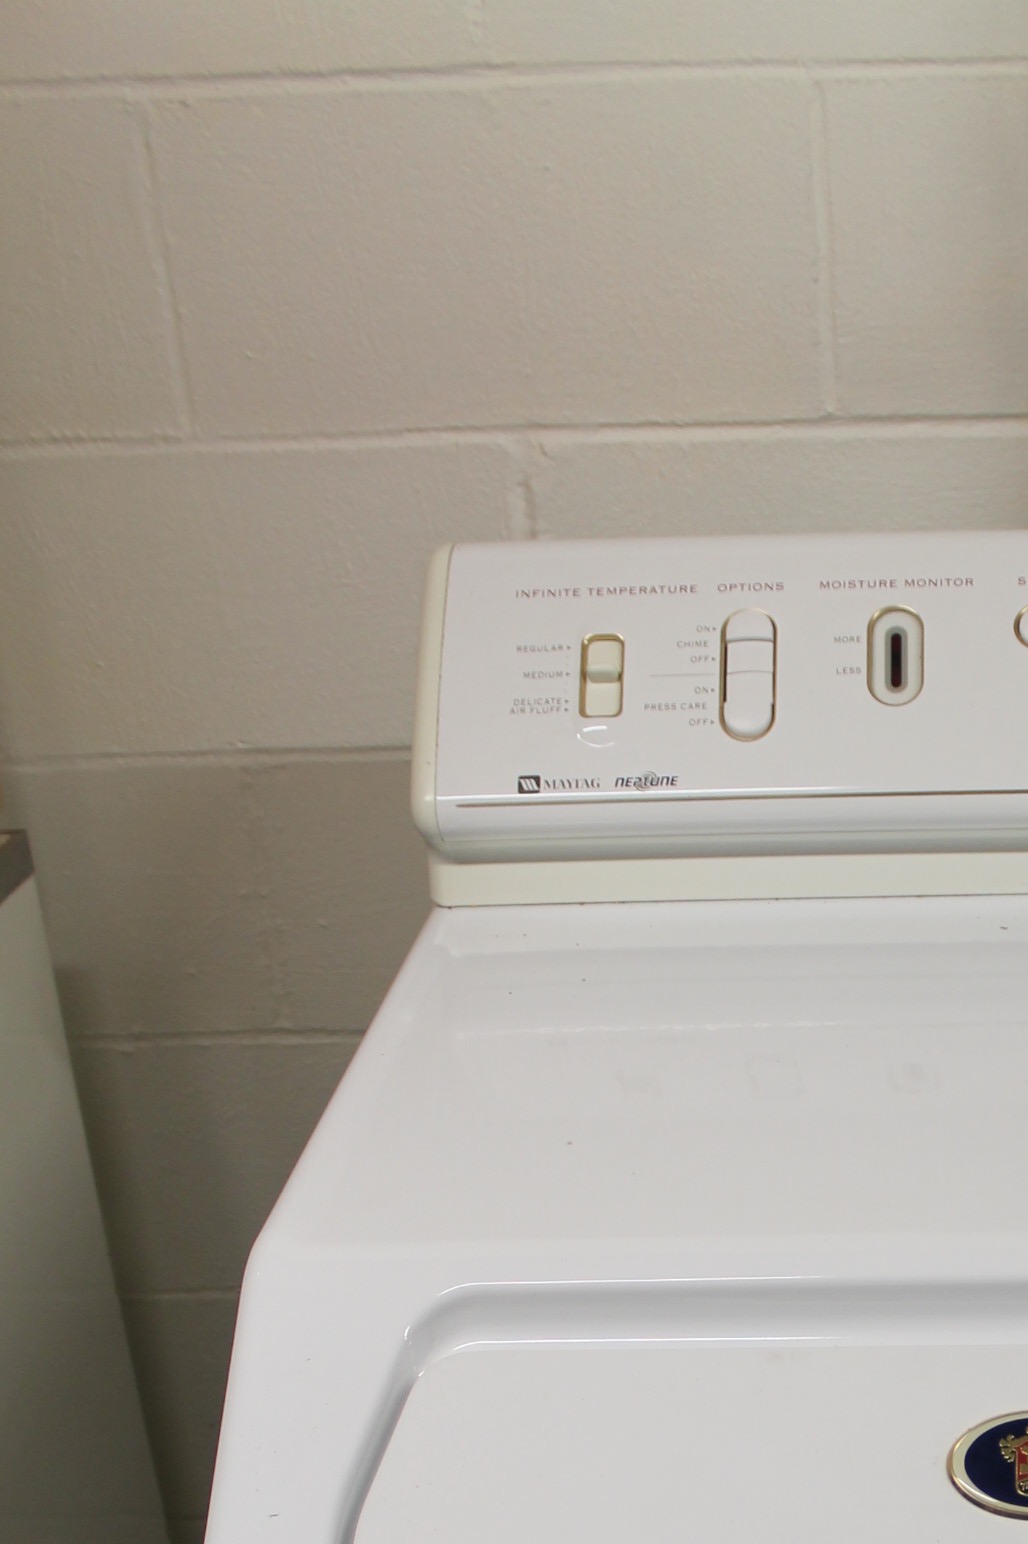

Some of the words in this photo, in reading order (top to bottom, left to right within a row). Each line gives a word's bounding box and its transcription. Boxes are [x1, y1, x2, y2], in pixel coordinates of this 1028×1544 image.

[717, 582, 785, 593] OPTIONS
[819, 579, 898, 590] MOISTURE
[904, 577, 974, 588] MONITOR
[515, 588, 581, 599] INFINITE
[587, 584, 698, 597] TEMPERATURE
[696, 624, 710, 633] ON
[676, 639, 709, 648] CHIME
[833, 635, 862, 644] MORE
[516, 644, 564, 653] REGULAR
[690, 654, 710, 664] OFF
[523, 670, 563, 679] MEDIUM
[836, 666, 862, 675] LESS
[694, 686, 709, 695] ON
[513, 697, 562, 706] DELICATE
[644, 702, 678, 711] PRESS
[681, 701, 708, 710] CARE
[509, 705, 527, 715] AIR
[688, 718, 708, 727] OFF
[543, 778, 601, 790] MAYTAG
